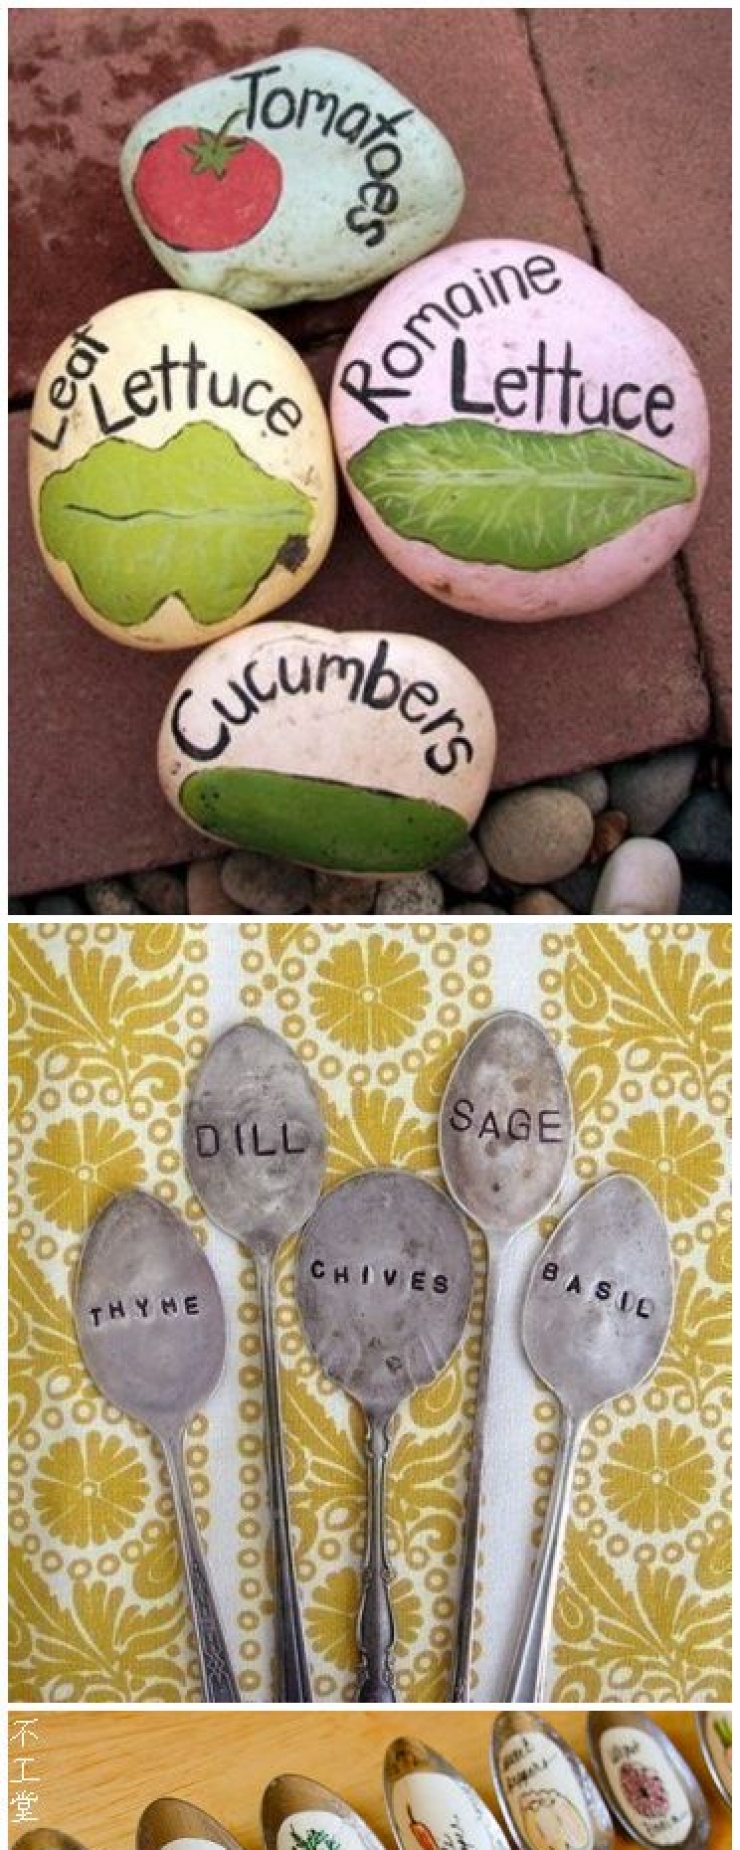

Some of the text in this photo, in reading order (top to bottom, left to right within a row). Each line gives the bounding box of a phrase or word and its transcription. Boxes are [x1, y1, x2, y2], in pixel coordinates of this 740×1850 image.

[233, 65, 415, 248] Tomatoes
[339, 253, 561, 422] Romaine
[90, 341, 302, 437] Lettuce
[449, 339, 676, 437] Lettuce
[170, 641, 475, 776] Cucumbers
[196, 1125, 306, 1158] DILL
[449, 1099, 563, 1143] SAGE
[90, 1296, 200, 1327] THYME
[311, 1260, 449, 1294] CHIVES
[542, 1262, 650, 1319] BASIL
